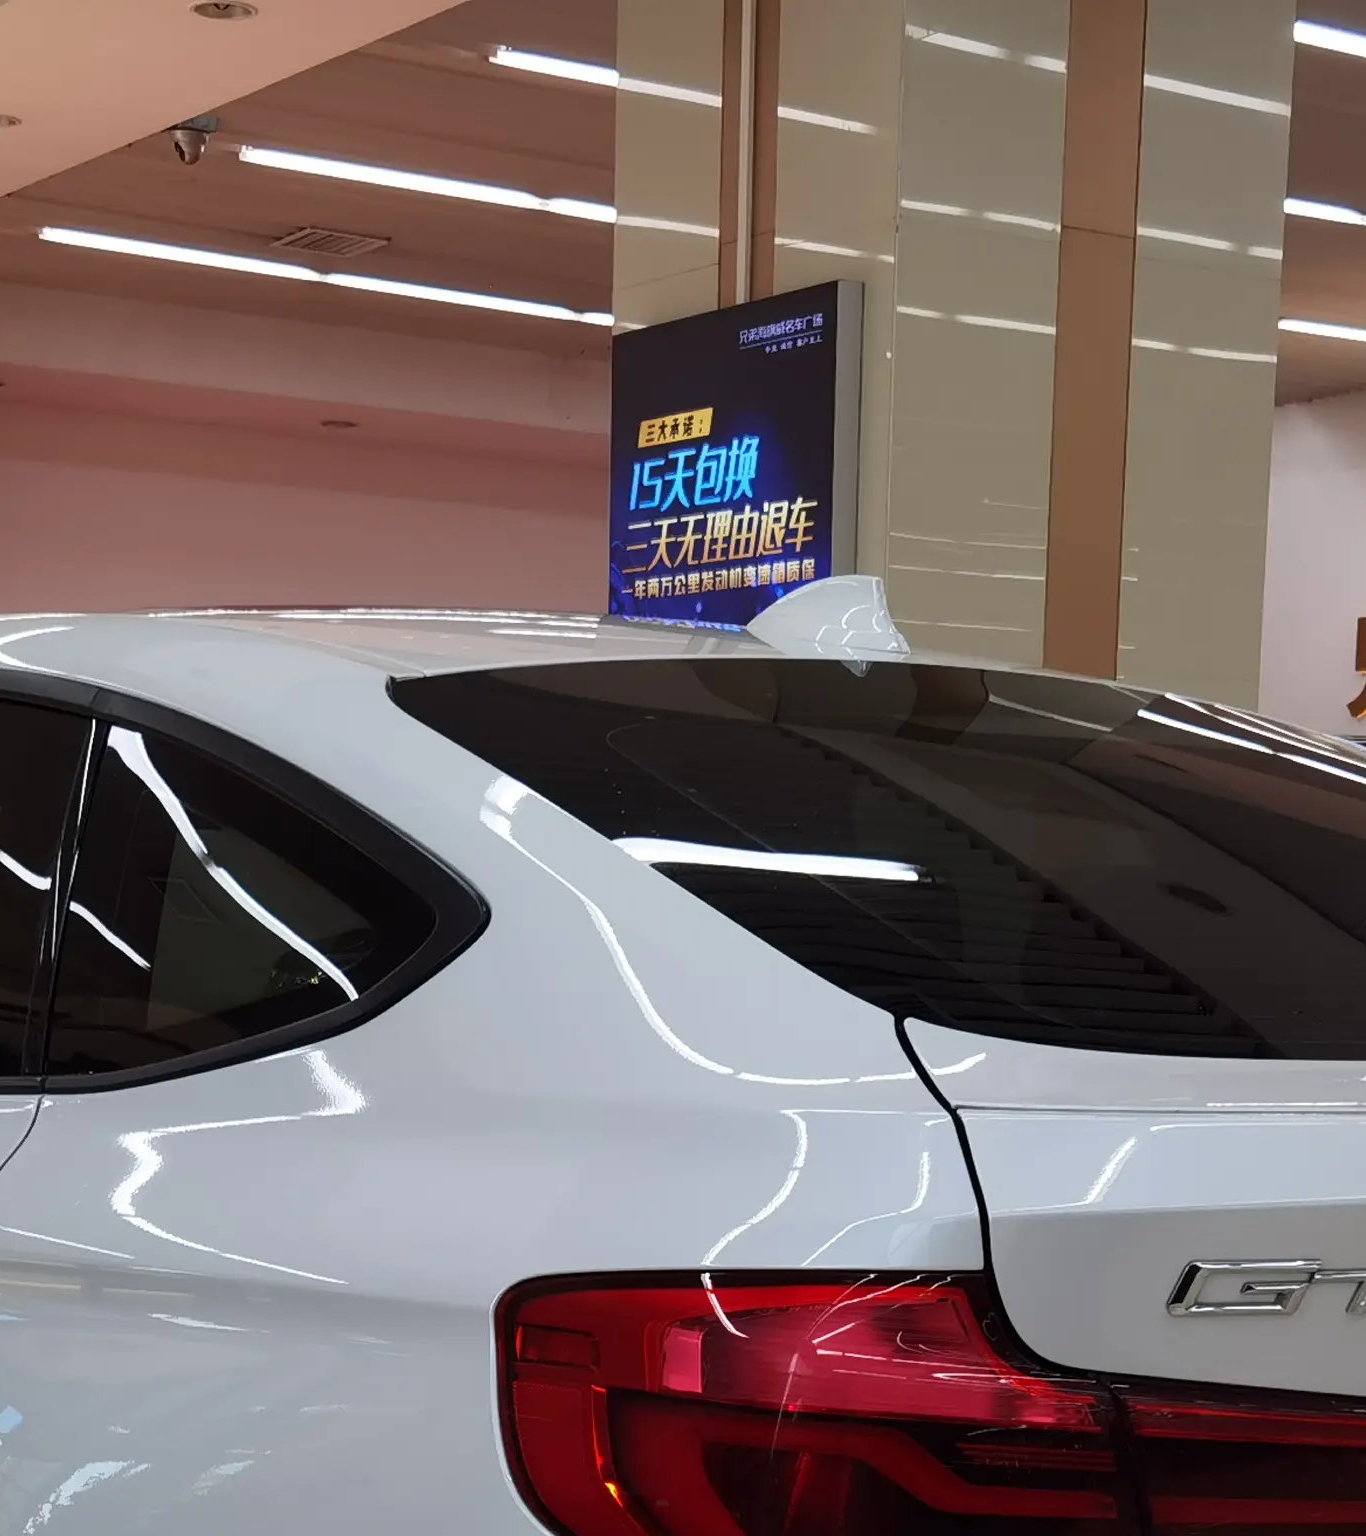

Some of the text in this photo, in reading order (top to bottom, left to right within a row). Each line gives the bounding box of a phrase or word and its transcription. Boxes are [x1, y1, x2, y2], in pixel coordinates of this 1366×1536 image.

[629, 434, 760, 512] 15天包换
[622, 495, 818, 574] 三天无理由退车
